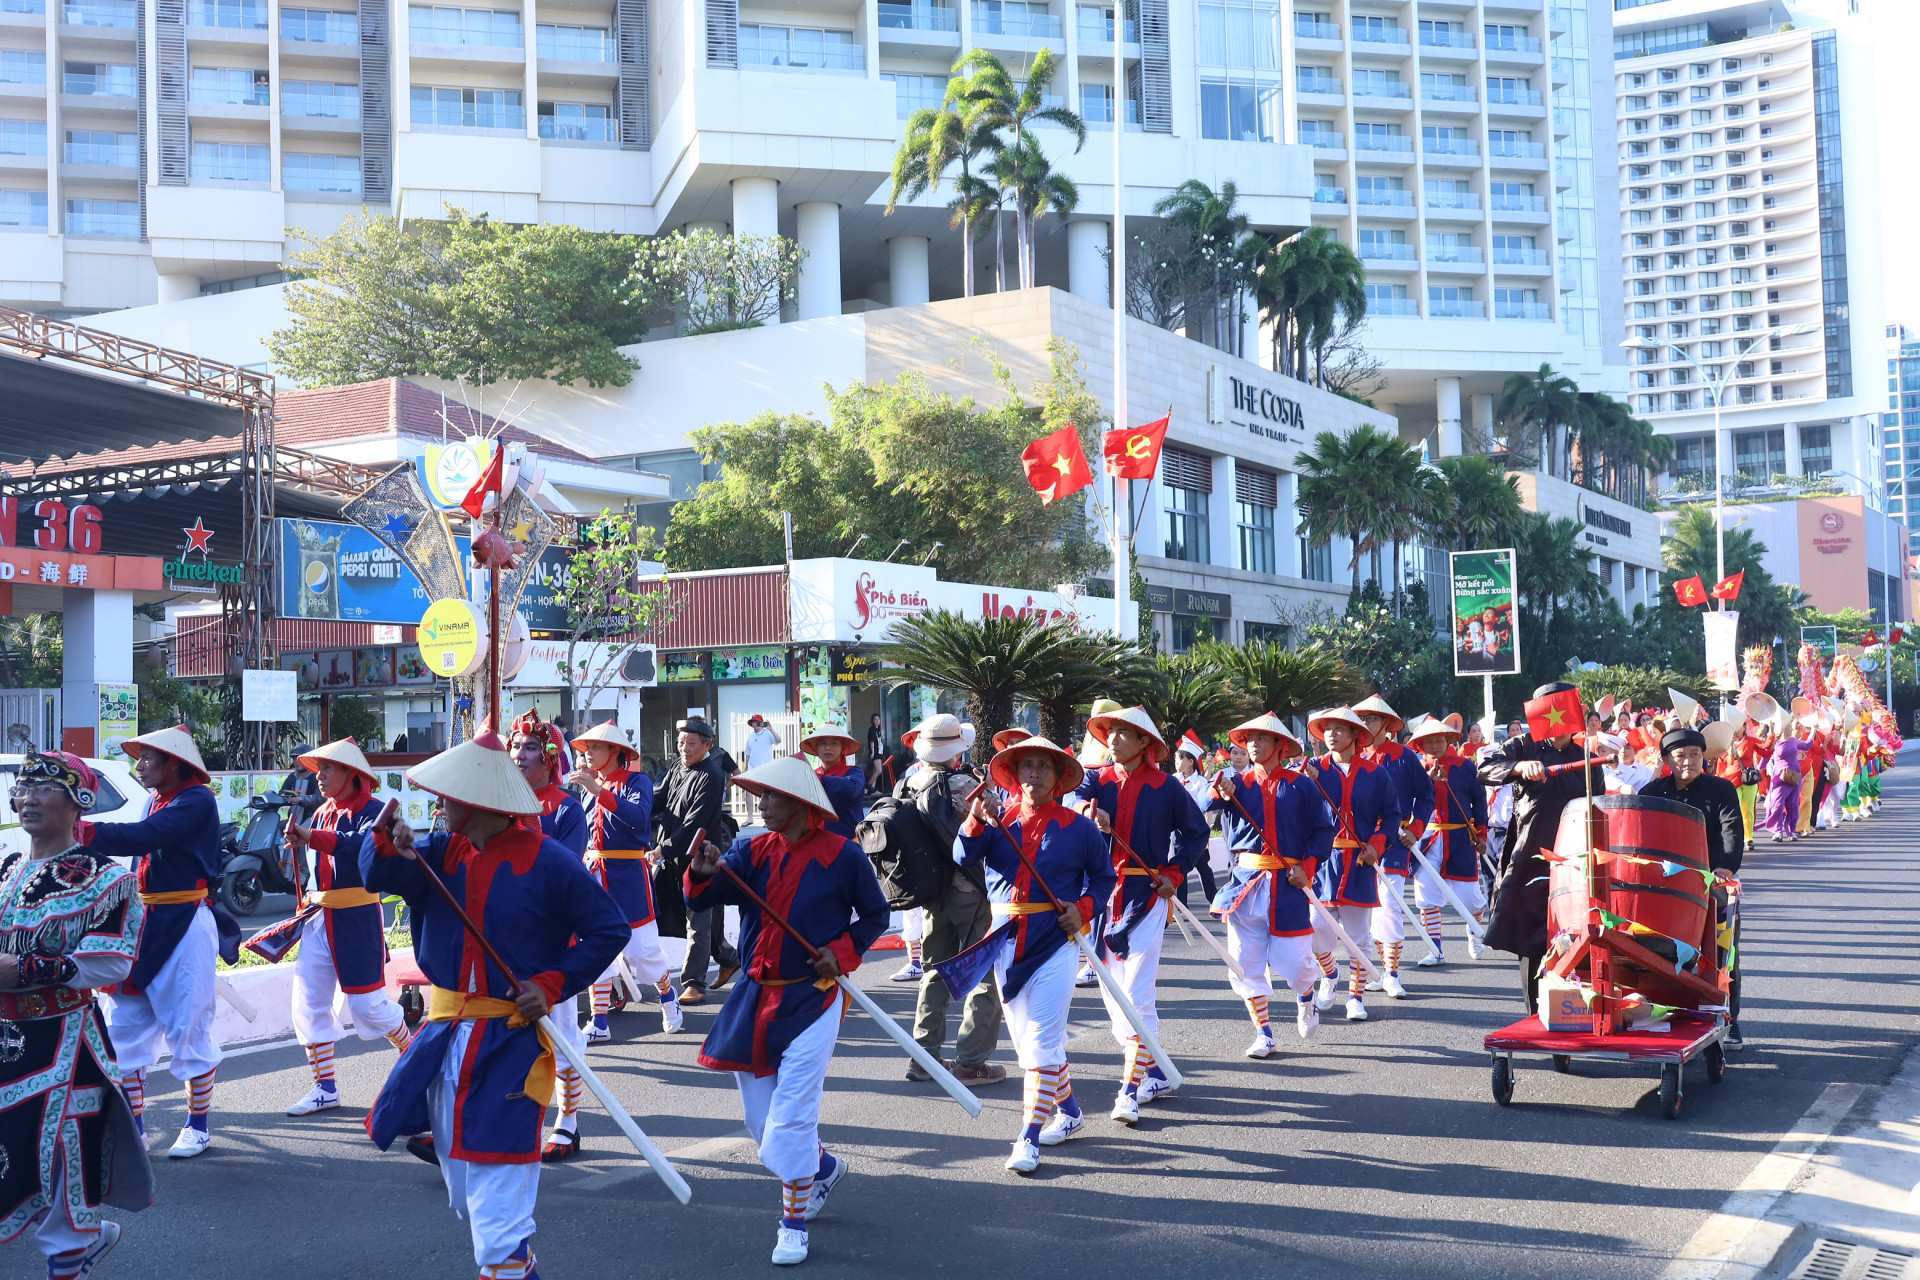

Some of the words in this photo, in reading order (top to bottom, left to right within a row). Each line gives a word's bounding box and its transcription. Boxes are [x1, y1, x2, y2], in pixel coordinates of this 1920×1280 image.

[1229, 376, 1259, 415] THE
[1261, 387, 1305, 430] COSTA
[1249, 423, 1264, 437] NHA
[1265, 428, 1288, 443] TRANG
[34, 500, 103, 555] 36
[163, 557, 243, 584] eineken
[341, 563, 368, 577] PEPSI
[552, 562, 574, 589] 36
[870, 589, 896, 605] Phố
[900, 590, 928, 607] Biển
[1491, 586, 1511, 595] xuân
[308, 597, 329, 607] pepsi
[520, 594, 533, 608] GHỊ
[438, 621, 470, 632] VINAMA
[530, 645, 567, 663] Coffee
[843, 653, 868, 670] Spa
